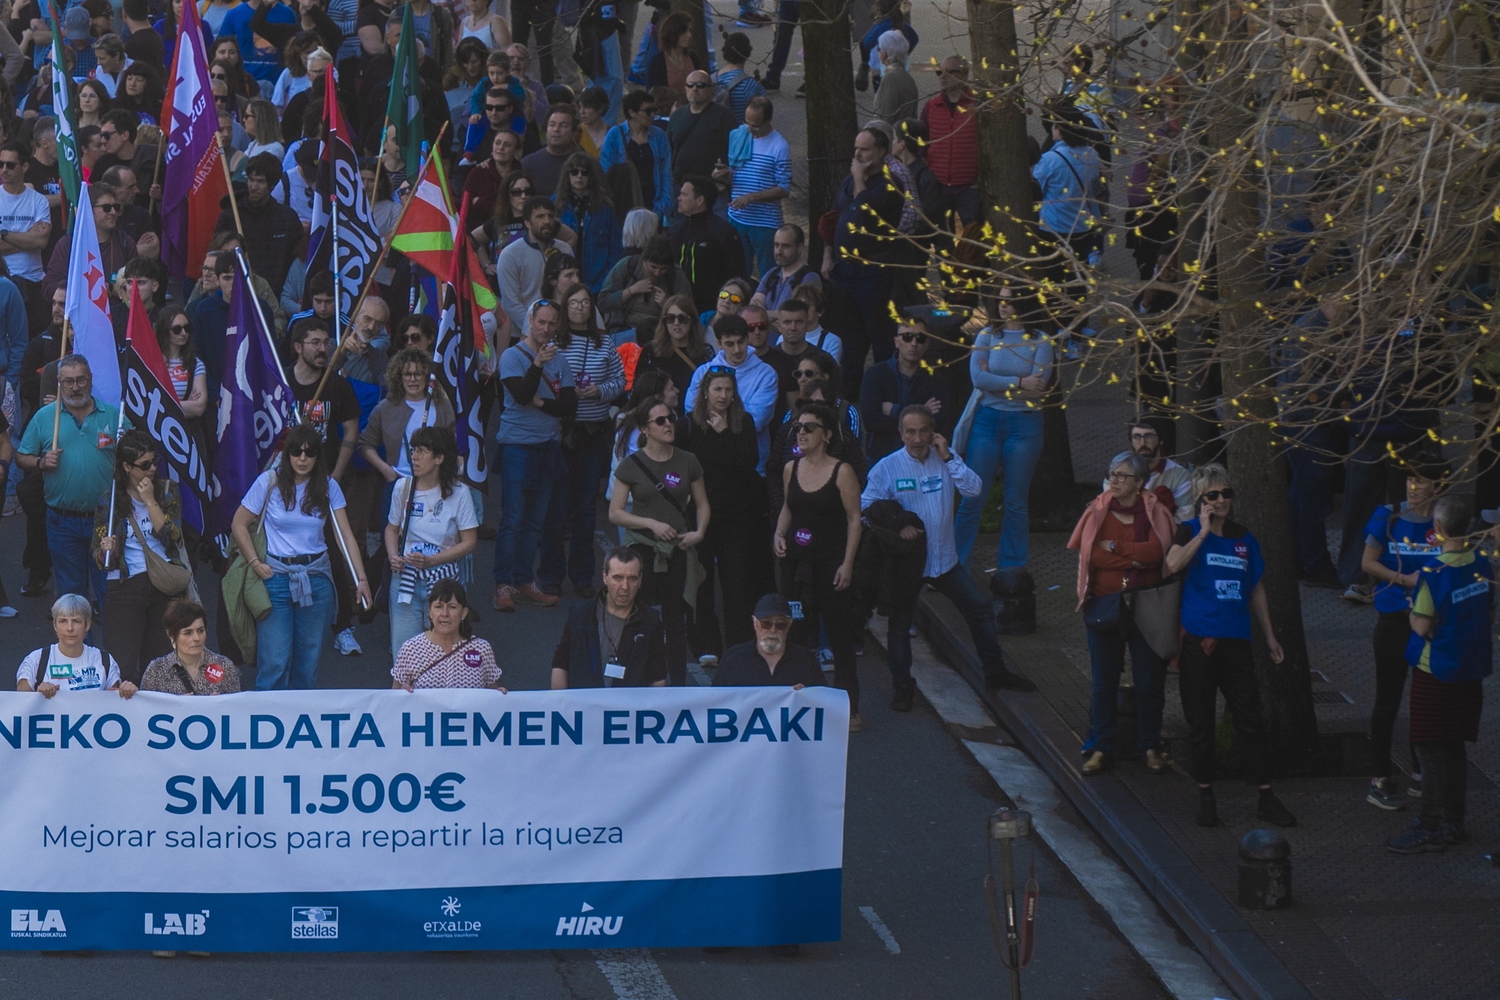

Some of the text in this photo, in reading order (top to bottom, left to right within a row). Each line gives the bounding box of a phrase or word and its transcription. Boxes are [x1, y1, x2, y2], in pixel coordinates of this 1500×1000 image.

[796, 532, 812, 540] LAB
[52, 668, 71, 677] ELA
[82, 667, 97, 676] M17
[206, 667, 223, 678] LAB
[147, 713, 386, 751] SOLDATA
[401, 711, 584, 748] HEMEN
[603, 706, 825, 745] ERABAKI
[165, 772, 466, 815] SMI 1.500€
[42, 820, 624, 855] Mejorar salarios para repartir la riqueza
[10, 909, 67, 932] ELA
[144, 910, 210, 936] LAB
[293, 923, 338, 938] steilas
[555, 916, 624, 936] HIRU
